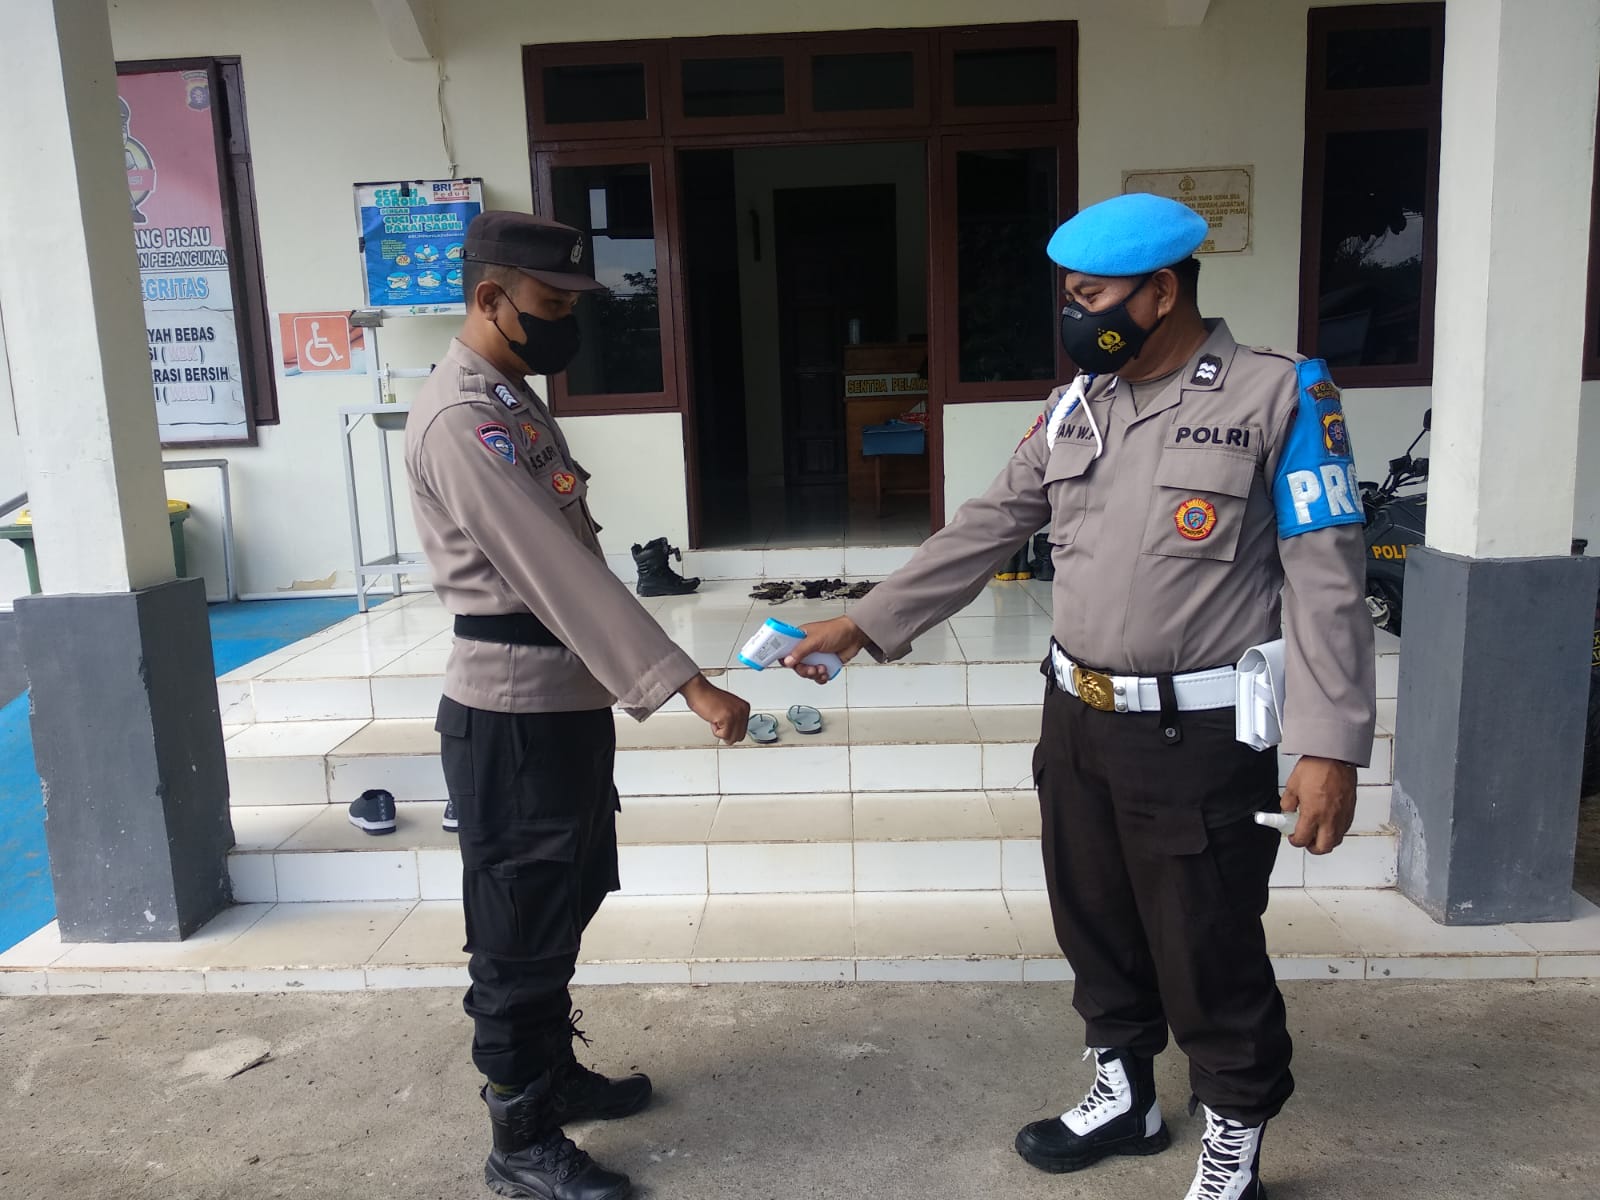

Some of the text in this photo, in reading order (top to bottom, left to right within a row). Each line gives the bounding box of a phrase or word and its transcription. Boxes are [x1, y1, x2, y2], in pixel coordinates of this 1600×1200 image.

[432, 183, 452, 191] BRI
[375, 196, 428, 207] CORONA
[384, 213, 457, 224] CUCI TANGAN
[385, 220, 463, 233] PAKAI SABUN
[165, 226, 211, 247] PISAU
[174, 326, 215, 342] BEBAS
[153, 366, 229, 383] RASI BERSIH
[847, 380, 888, 393] SENTRA
[1056, 423, 1076, 439] AN
[1175, 426, 1250, 448] POLRI
[1371, 543, 1420, 560] POLI
